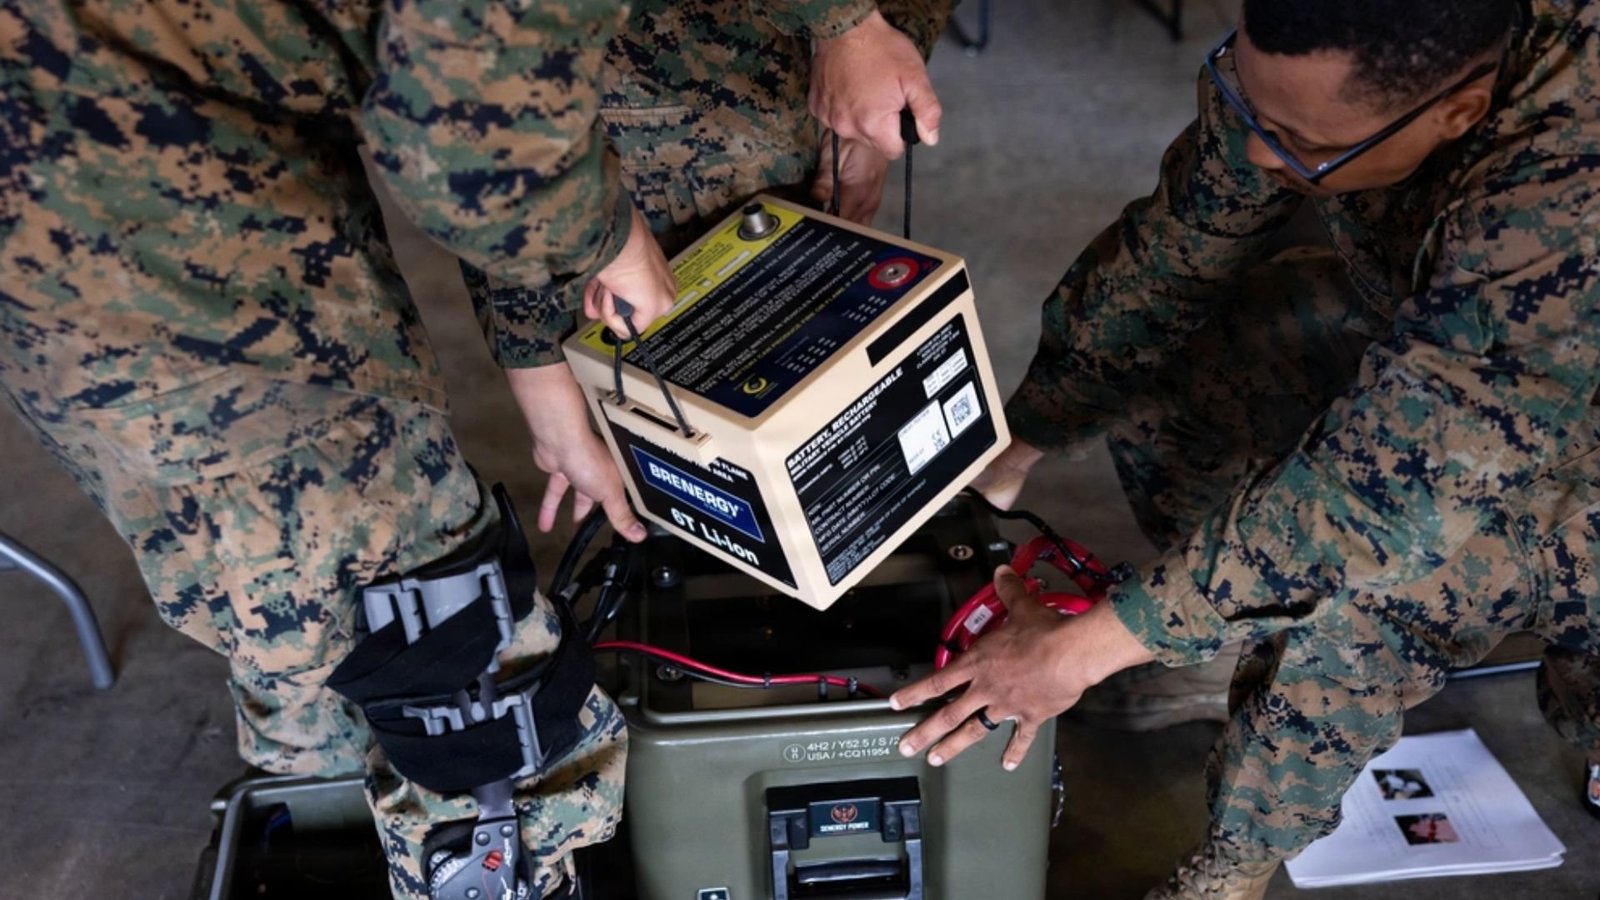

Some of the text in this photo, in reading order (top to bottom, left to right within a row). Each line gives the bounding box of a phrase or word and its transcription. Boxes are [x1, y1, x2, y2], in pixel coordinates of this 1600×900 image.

[786, 426, 832, 470] BATTERY,
[831, 365, 903, 432] RECHARGEABLE
[820, 422, 849, 450] VEHICLE
[848, 398, 878, 427] BATTERY
[648, 461, 739, 518] BRENERGY
[670, 507, 695, 532] 6T
[806, 742, 829, 752] 4H2
[807, 752, 830, 760] USA
